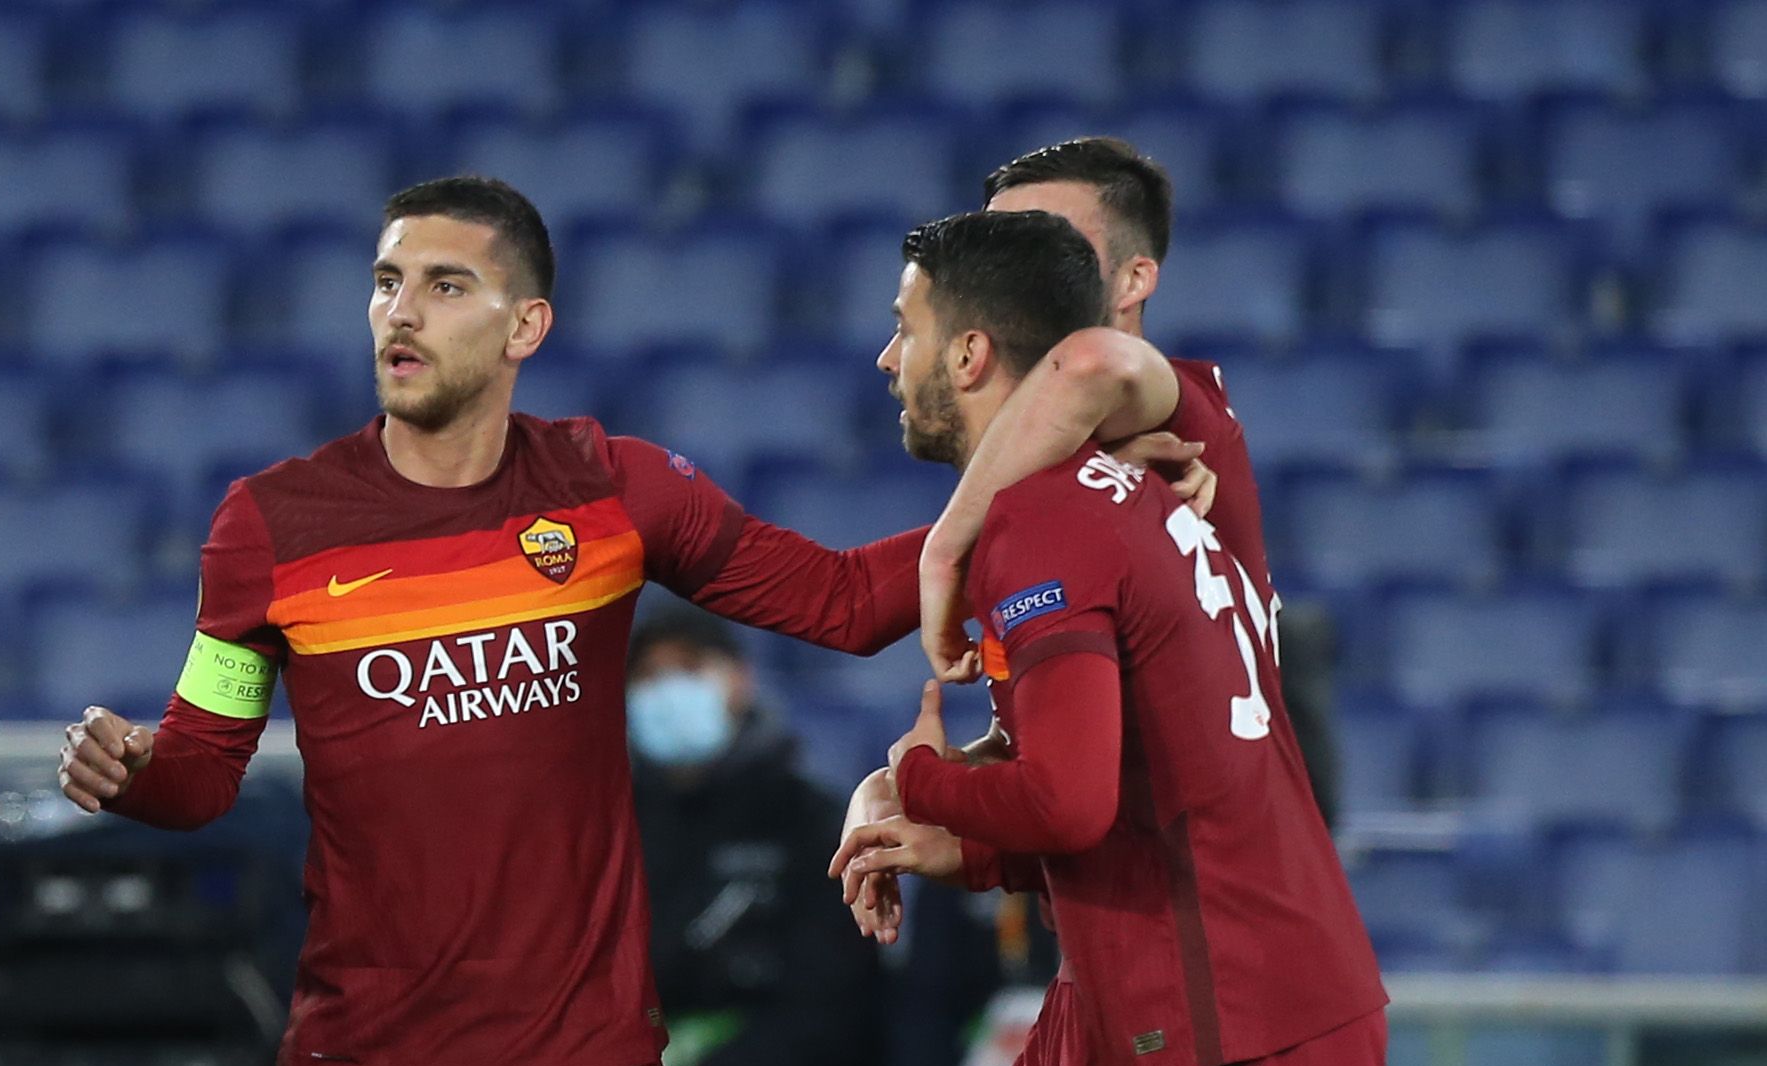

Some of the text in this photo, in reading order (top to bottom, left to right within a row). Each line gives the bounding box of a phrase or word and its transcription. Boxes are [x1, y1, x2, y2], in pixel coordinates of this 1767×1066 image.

[534, 552, 574, 568] ROMA
[1002, 588, 1063, 622] RESPECT
[214, 654, 236, 669] NO
[239, 662, 257, 675] TO
[356, 618, 579, 708] QATAR
[418, 670, 582, 729] AIRWAYS
